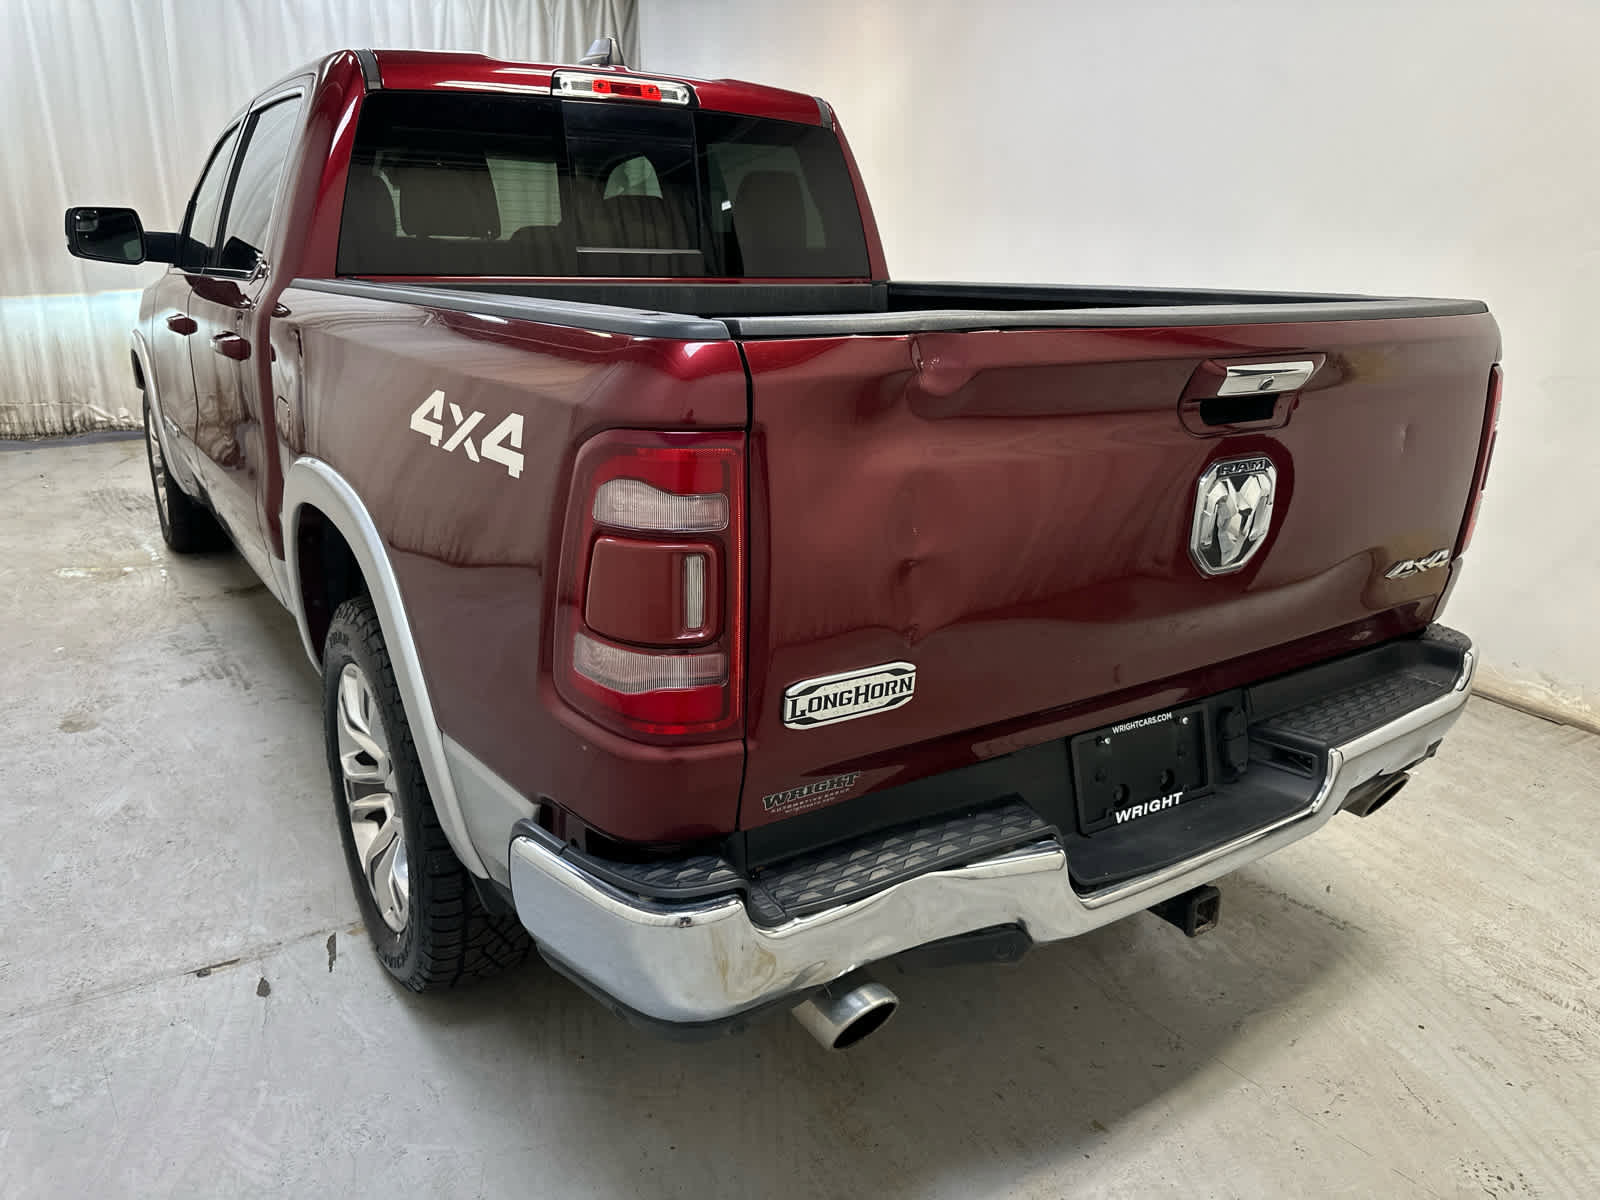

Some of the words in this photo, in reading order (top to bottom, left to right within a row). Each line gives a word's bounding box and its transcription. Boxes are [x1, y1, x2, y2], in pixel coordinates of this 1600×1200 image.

[1221, 460, 1265, 474] RAM
[790, 676, 914, 719] LONGHORN
[1112, 712, 1172, 734] WRIGHTCARS.COM
[763, 773, 860, 811] WRIGHT
[1115, 791, 1184, 824] WRIGHT
